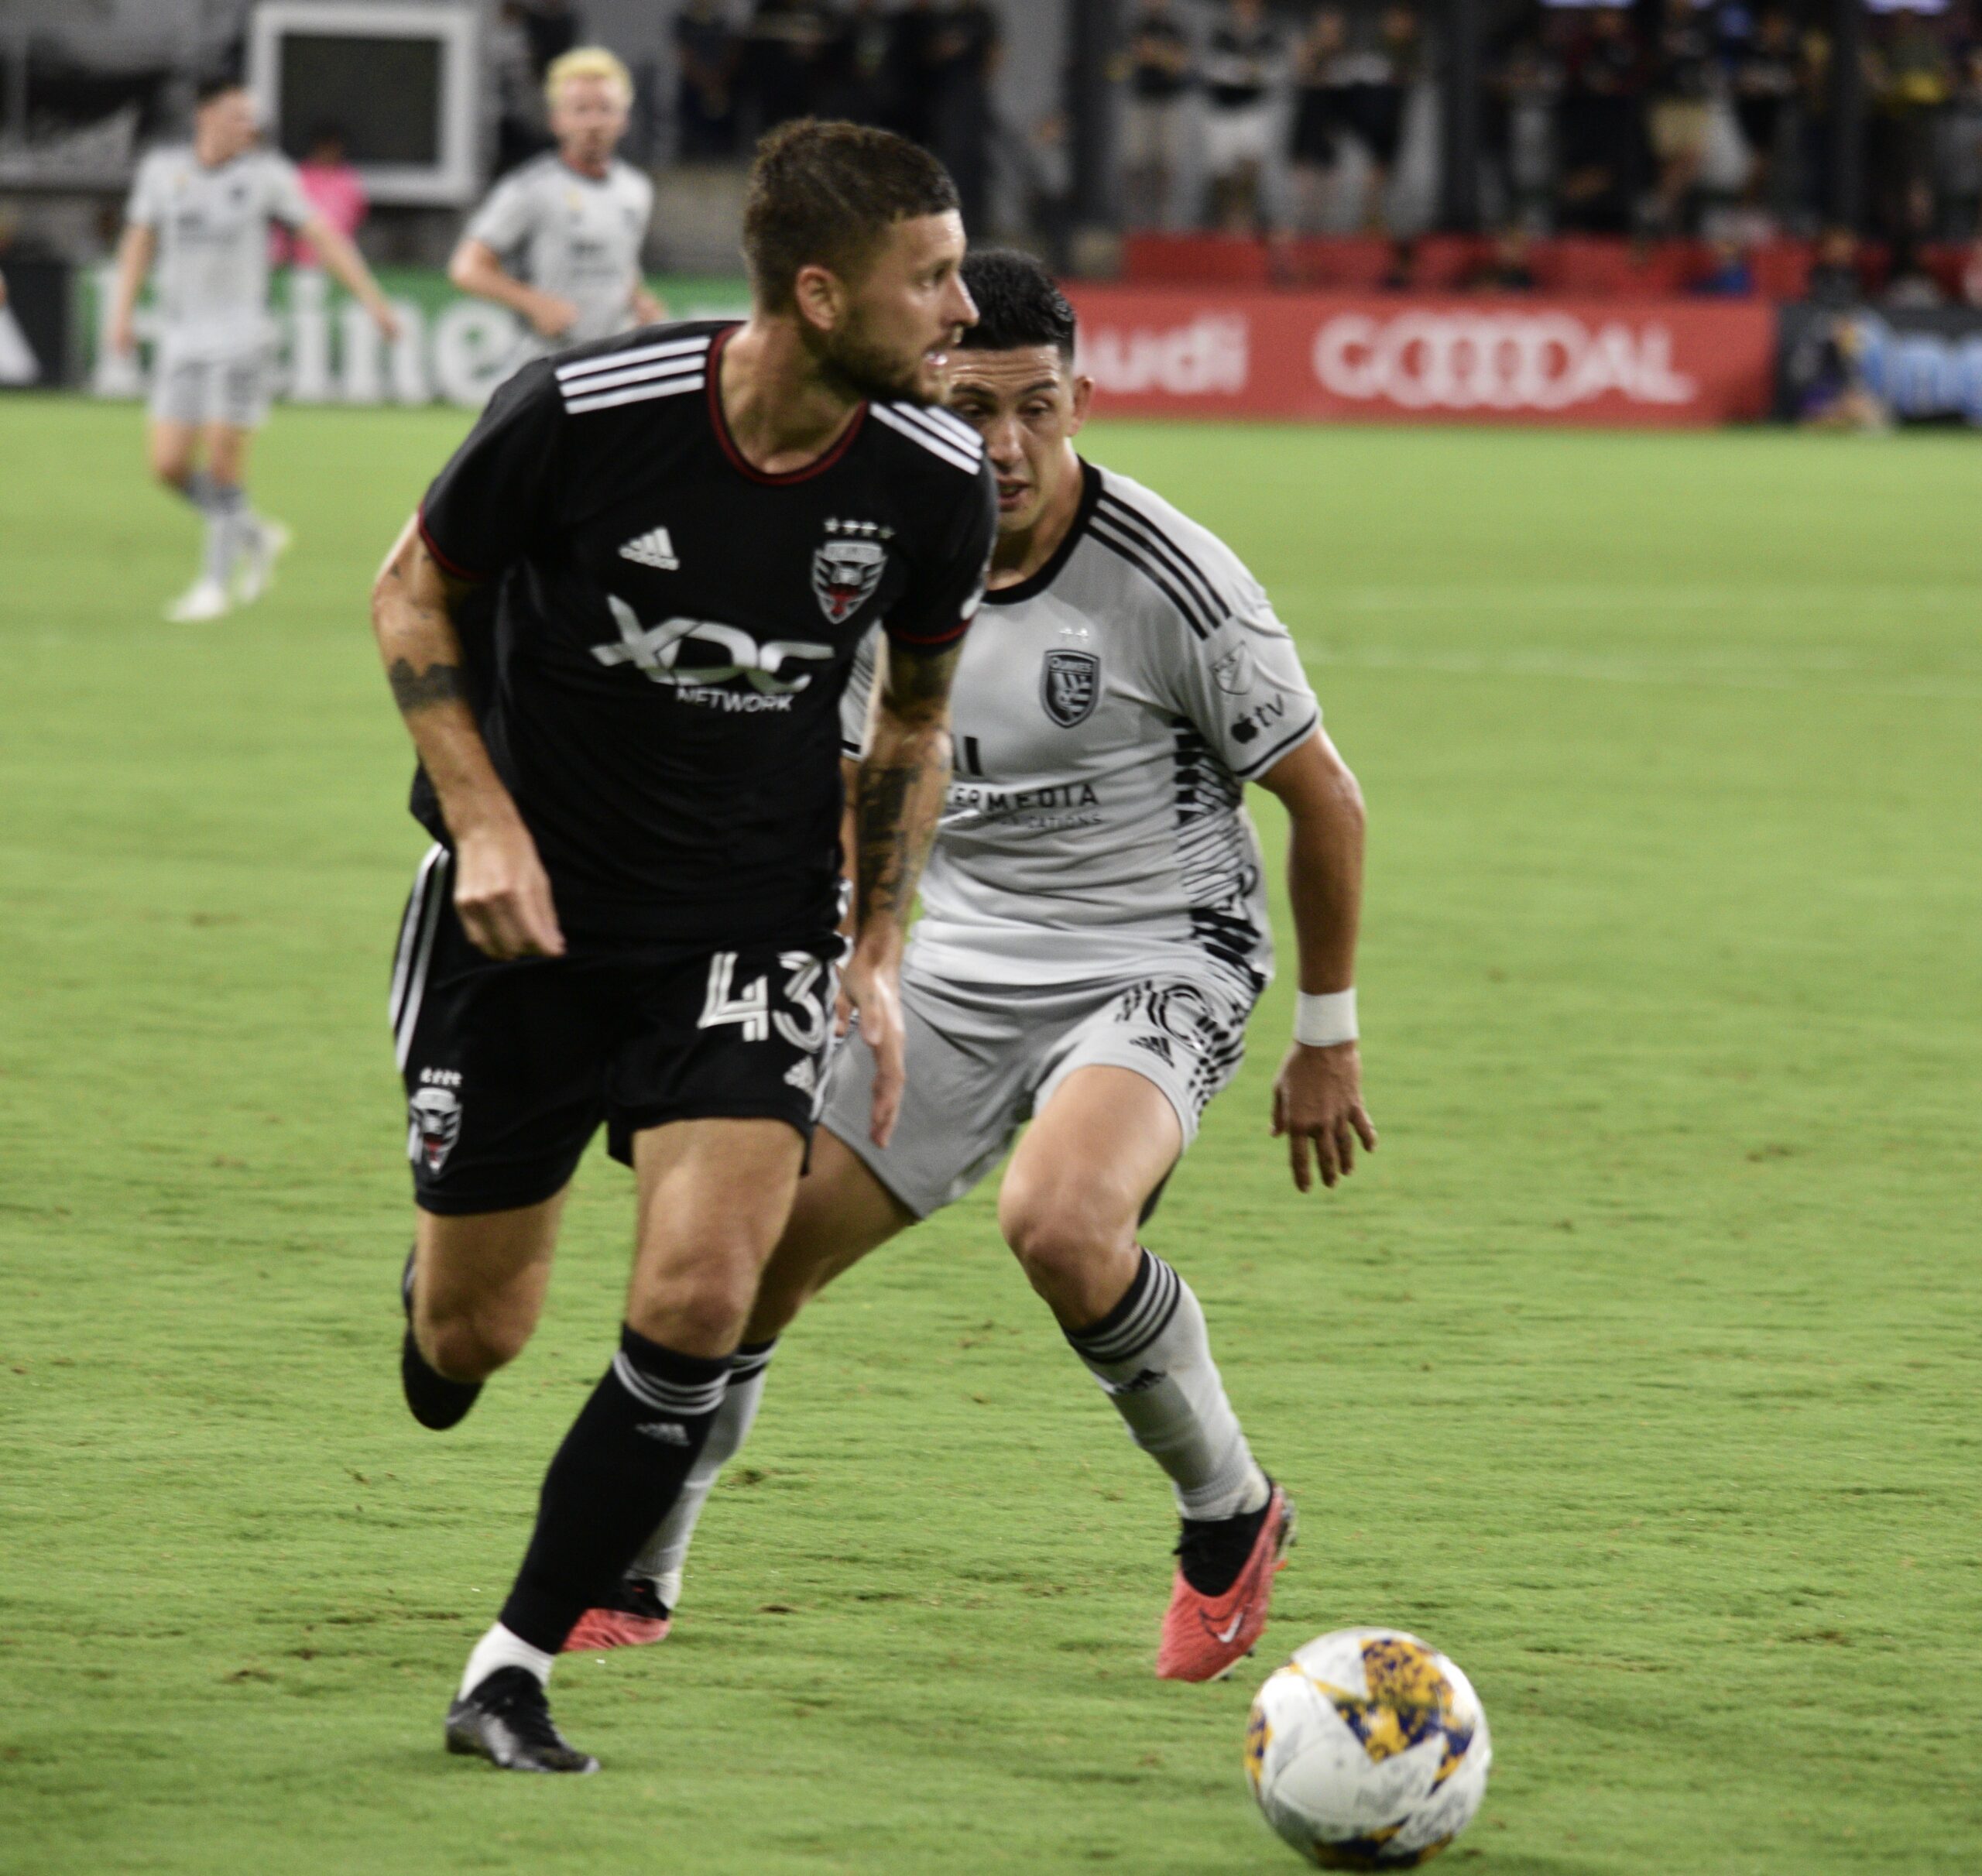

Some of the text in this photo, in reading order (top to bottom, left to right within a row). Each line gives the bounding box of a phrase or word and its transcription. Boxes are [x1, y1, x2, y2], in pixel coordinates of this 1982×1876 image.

[1073, 311, 1248, 396] udi
[676, 684, 795, 713] NETWORK
[948, 781, 1099, 813] ERMEDIA
[697, 950, 827, 1055] 43
